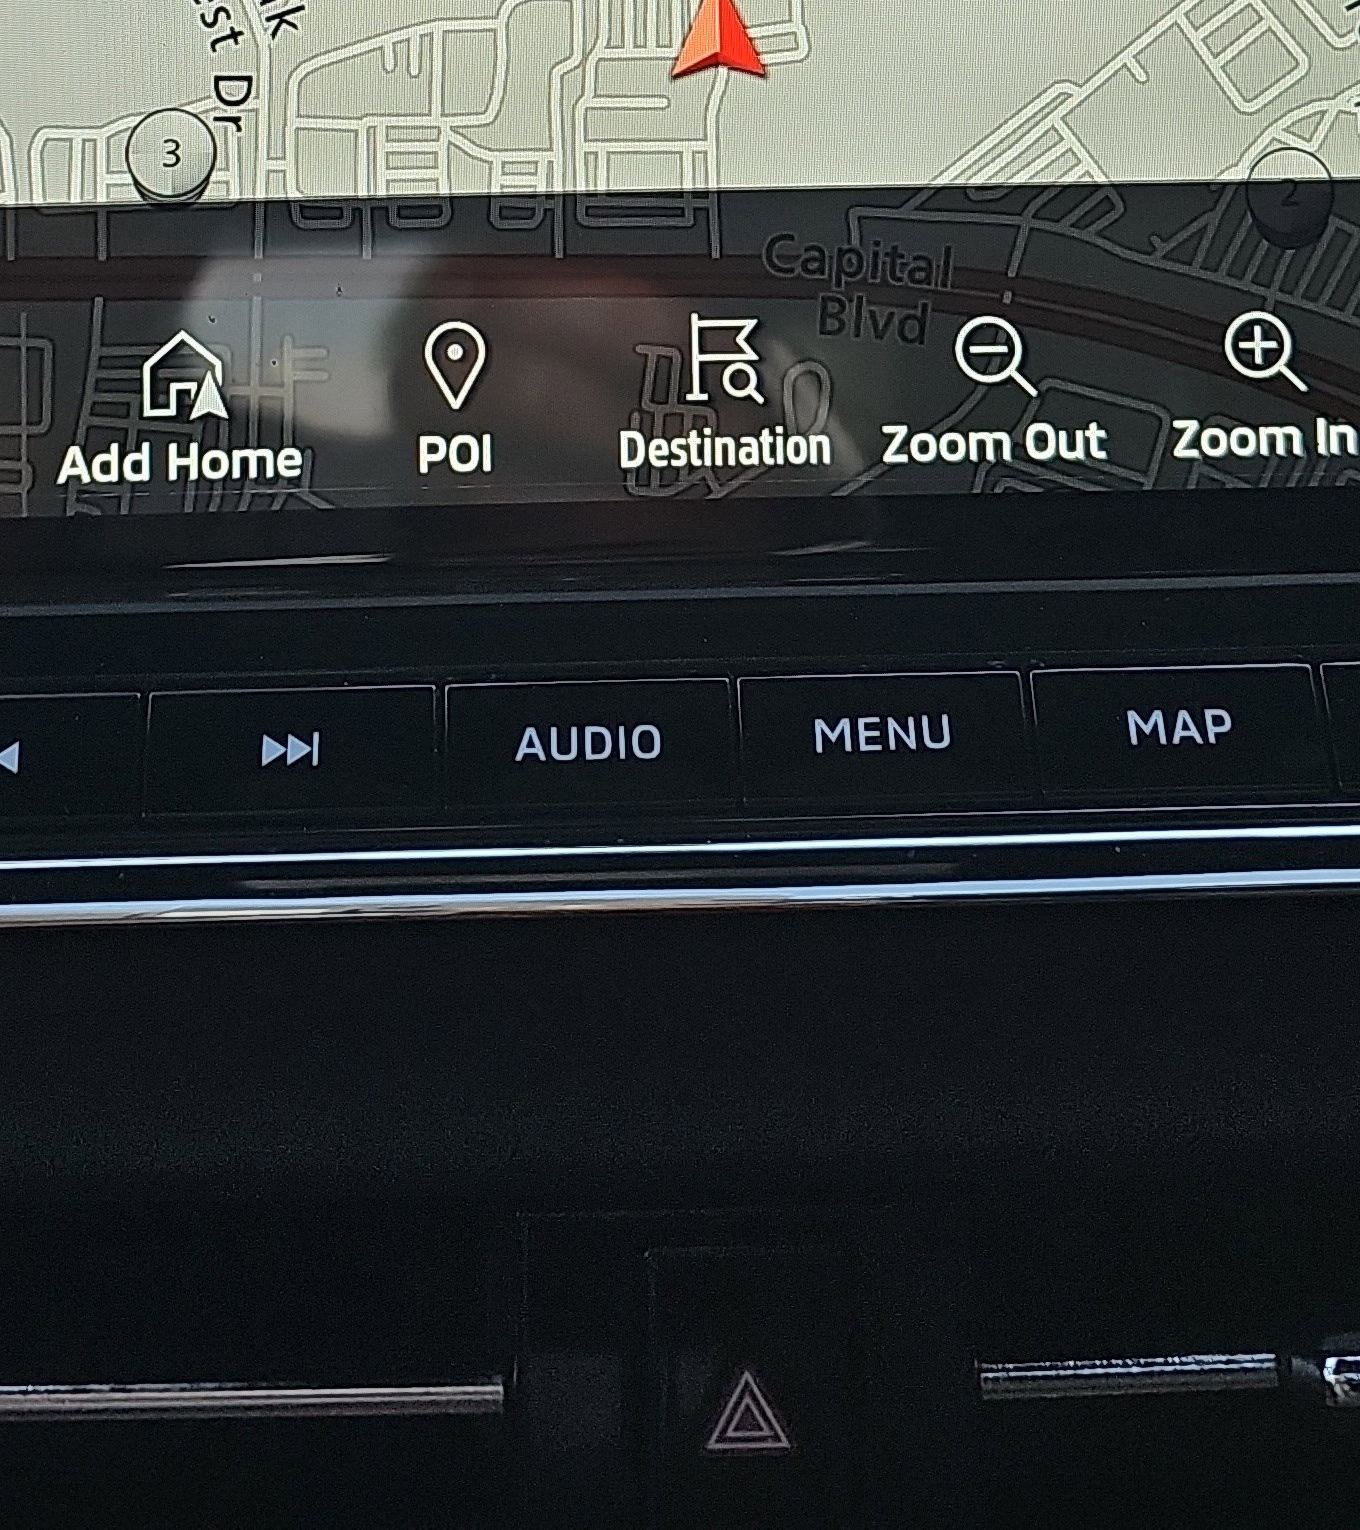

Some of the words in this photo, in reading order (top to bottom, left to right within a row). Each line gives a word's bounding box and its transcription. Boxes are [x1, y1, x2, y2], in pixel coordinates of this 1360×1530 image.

[214, 75, 254, 133] Dr
[162, 139, 181, 168] 3
[764, 233, 953, 290] Capital
[819, 294, 929, 345] Blvd
[419, 434, 492, 474] POI
[618, 427, 831, 469] Destination
[881, 425, 1011, 464] Zoom
[1025, 421, 1108, 460] Out
[1172, 420, 1301, 459] Zoom
[1316, 417, 1359, 455] In
[57, 442, 151, 485] Add
[167, 440, 303, 481] Home
[514, 724, 662, 762] AUDIO
[814, 714, 951, 753] MENU
[1126, 708, 1233, 746] MAP
